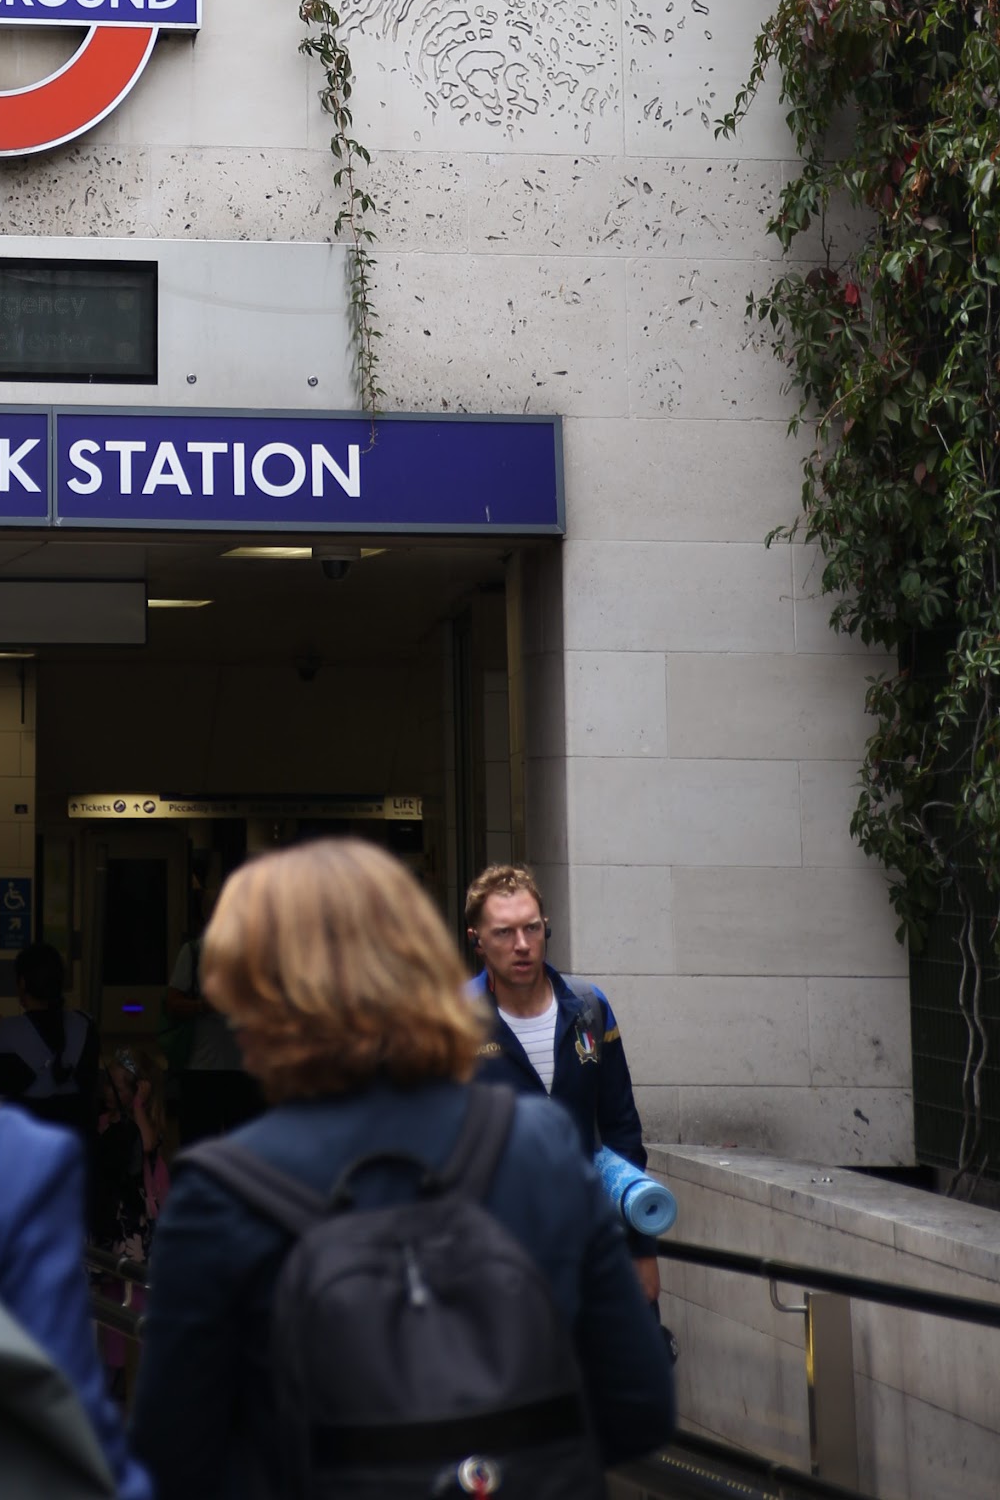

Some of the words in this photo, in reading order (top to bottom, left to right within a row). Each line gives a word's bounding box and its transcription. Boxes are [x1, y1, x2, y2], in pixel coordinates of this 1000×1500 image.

[66, 438, 361, 498] STATION
[80, 803, 111, 812] Tickets
[393, 798, 414, 809] Lift
